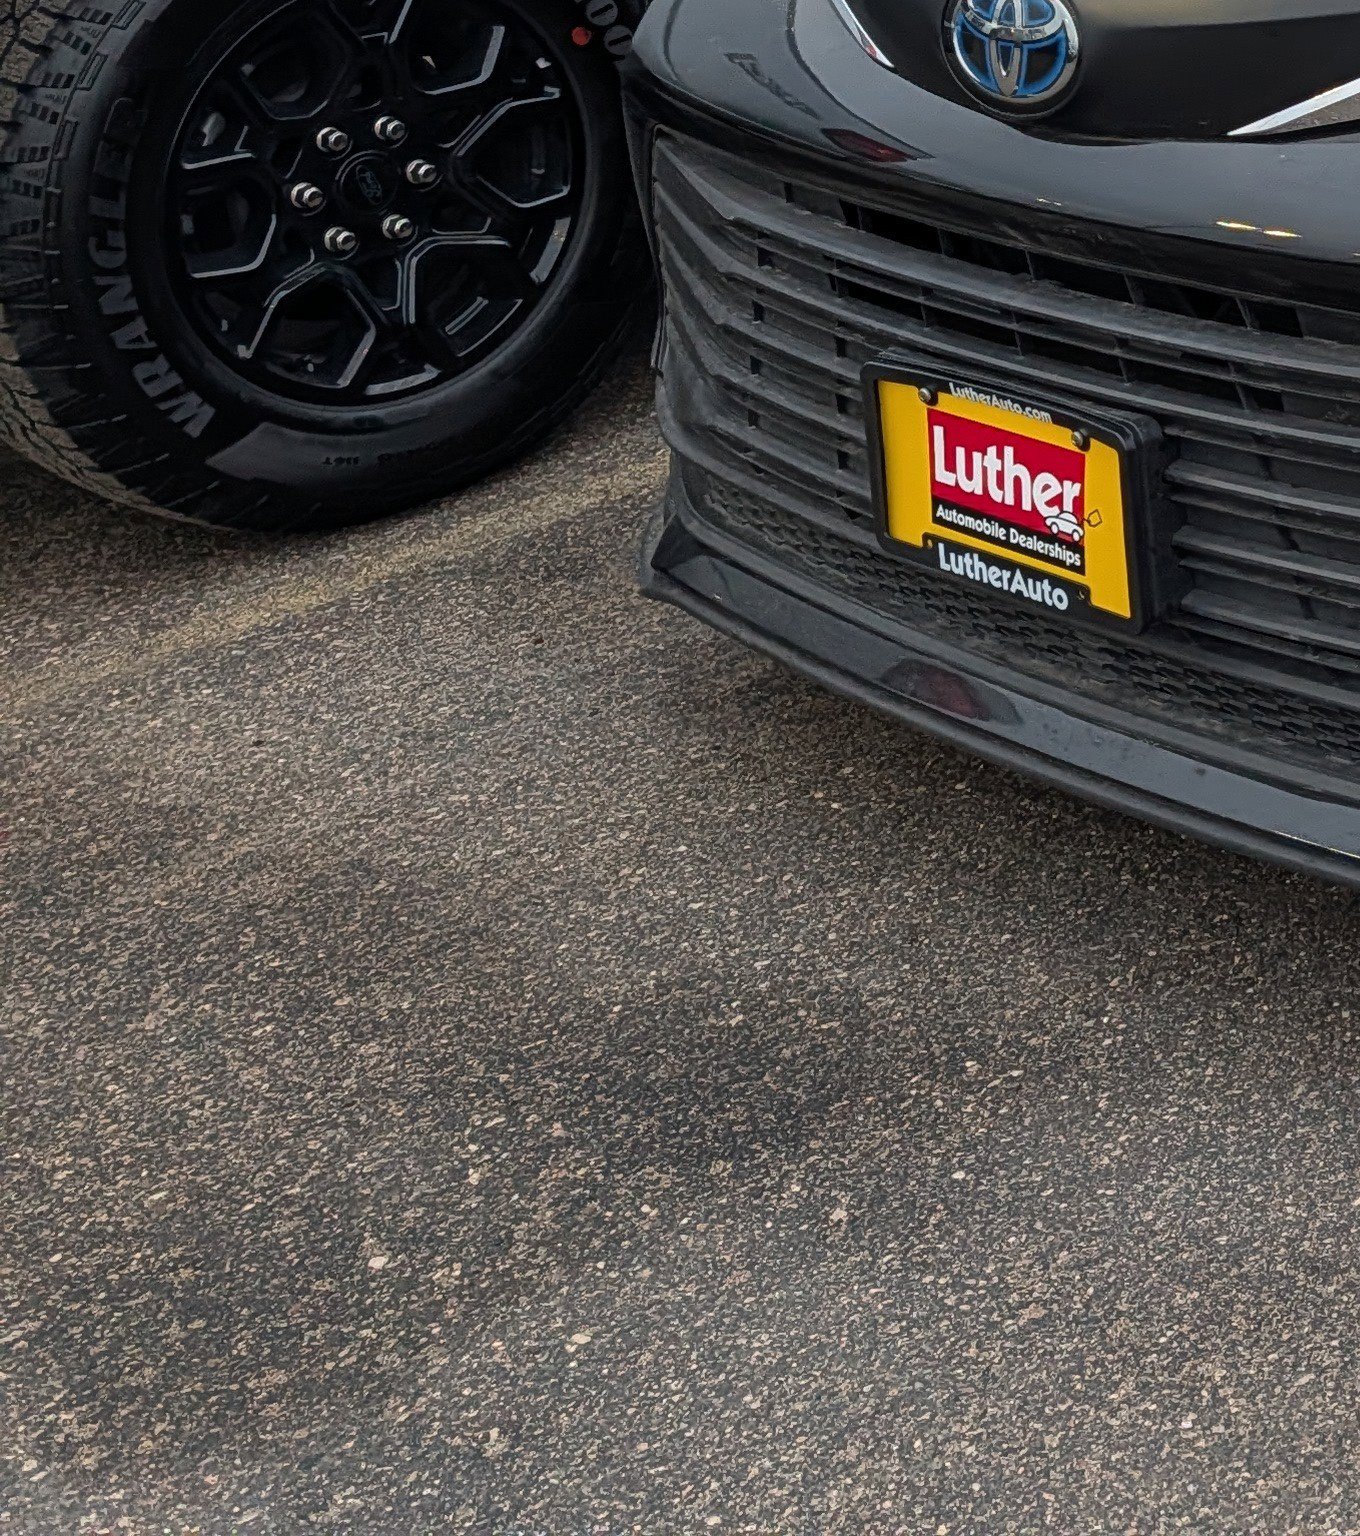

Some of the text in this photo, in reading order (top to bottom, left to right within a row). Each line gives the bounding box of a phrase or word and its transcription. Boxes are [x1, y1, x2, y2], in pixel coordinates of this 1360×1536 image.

[949, 381, 1053, 424] LutherAuto.com
[932, 424, 1082, 517] Luther
[936, 504, 1082, 568] Automobile Dealerships
[938, 543, 1069, 611] LutherAuto
